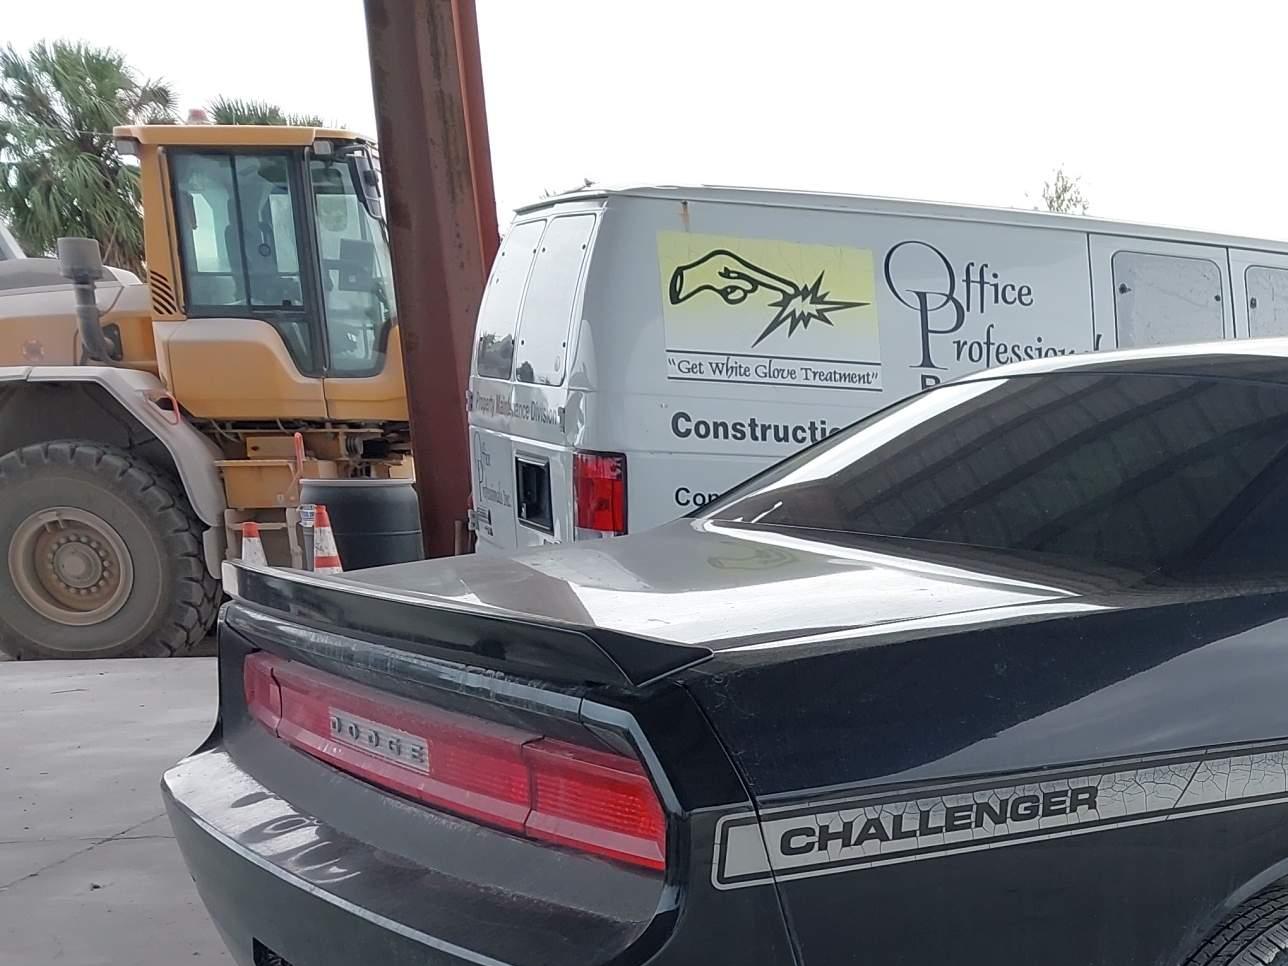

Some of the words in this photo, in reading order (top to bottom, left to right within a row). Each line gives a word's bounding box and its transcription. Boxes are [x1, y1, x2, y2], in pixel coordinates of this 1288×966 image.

[884, 240, 1034, 314] Office
[905, 289, 1102, 371] Professio
[667, 358, 705, 375] "Get
[708, 356, 751, 379] White
[754, 359, 797, 381] Glove
[800, 367, 879, 385] Treatment"
[530, 400, 557, 425] Division
[330, 715, 425, 763] DODGE
[779, 785, 1099, 857] CHALLENGER
